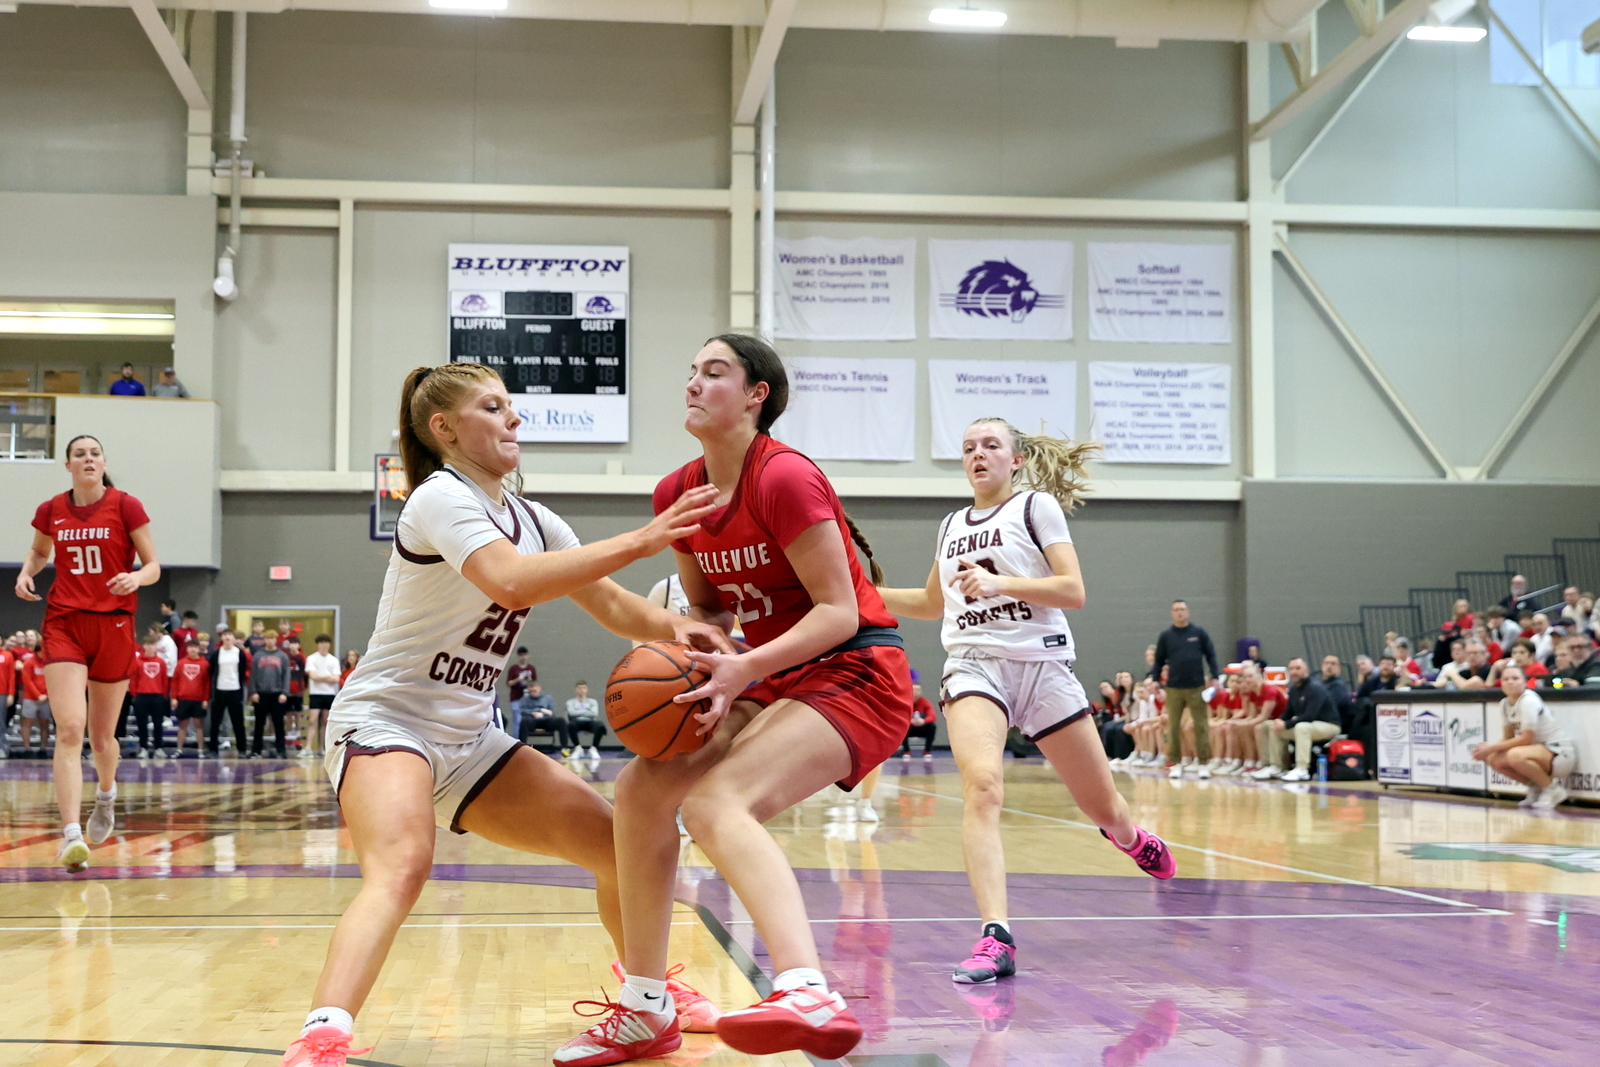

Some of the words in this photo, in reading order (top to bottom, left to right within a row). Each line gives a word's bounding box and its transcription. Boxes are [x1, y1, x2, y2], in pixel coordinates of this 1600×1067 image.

[452, 257, 626, 272] BLUFFTON
[779, 253, 836, 264] Women's
[840, 253, 904, 265] Basketball
[1137, 264, 1180, 275] Softball
[453, 318, 506, 330] BLUFFTON
[525, 324, 552, 333] PERIOD
[581, 319, 616, 331] GUEST
[513, 356, 541, 365] PLAYER
[544, 356, 562, 365] FOUL
[595, 357, 619, 365] FOULS
[794, 371, 847, 382] Women's
[851, 371, 889, 382] Tennis
[956, 373, 1011, 384] Women's
[1015, 373, 1048, 384] Track
[1133, 367, 1188, 379] Volleyball
[525, 386, 552, 394] MATCH
[595, 386, 619, 394] SCORE
[57, 527, 110, 541] BELLEVUE
[946, 528, 1004, 559] GENOA
[66, 545, 103, 575] 30
[716, 582, 773, 625] 21
[956, 600, 1033, 630] COMETS
[463, 602, 532, 659] 25
[1411, 721, 1443, 735] STOLLY
